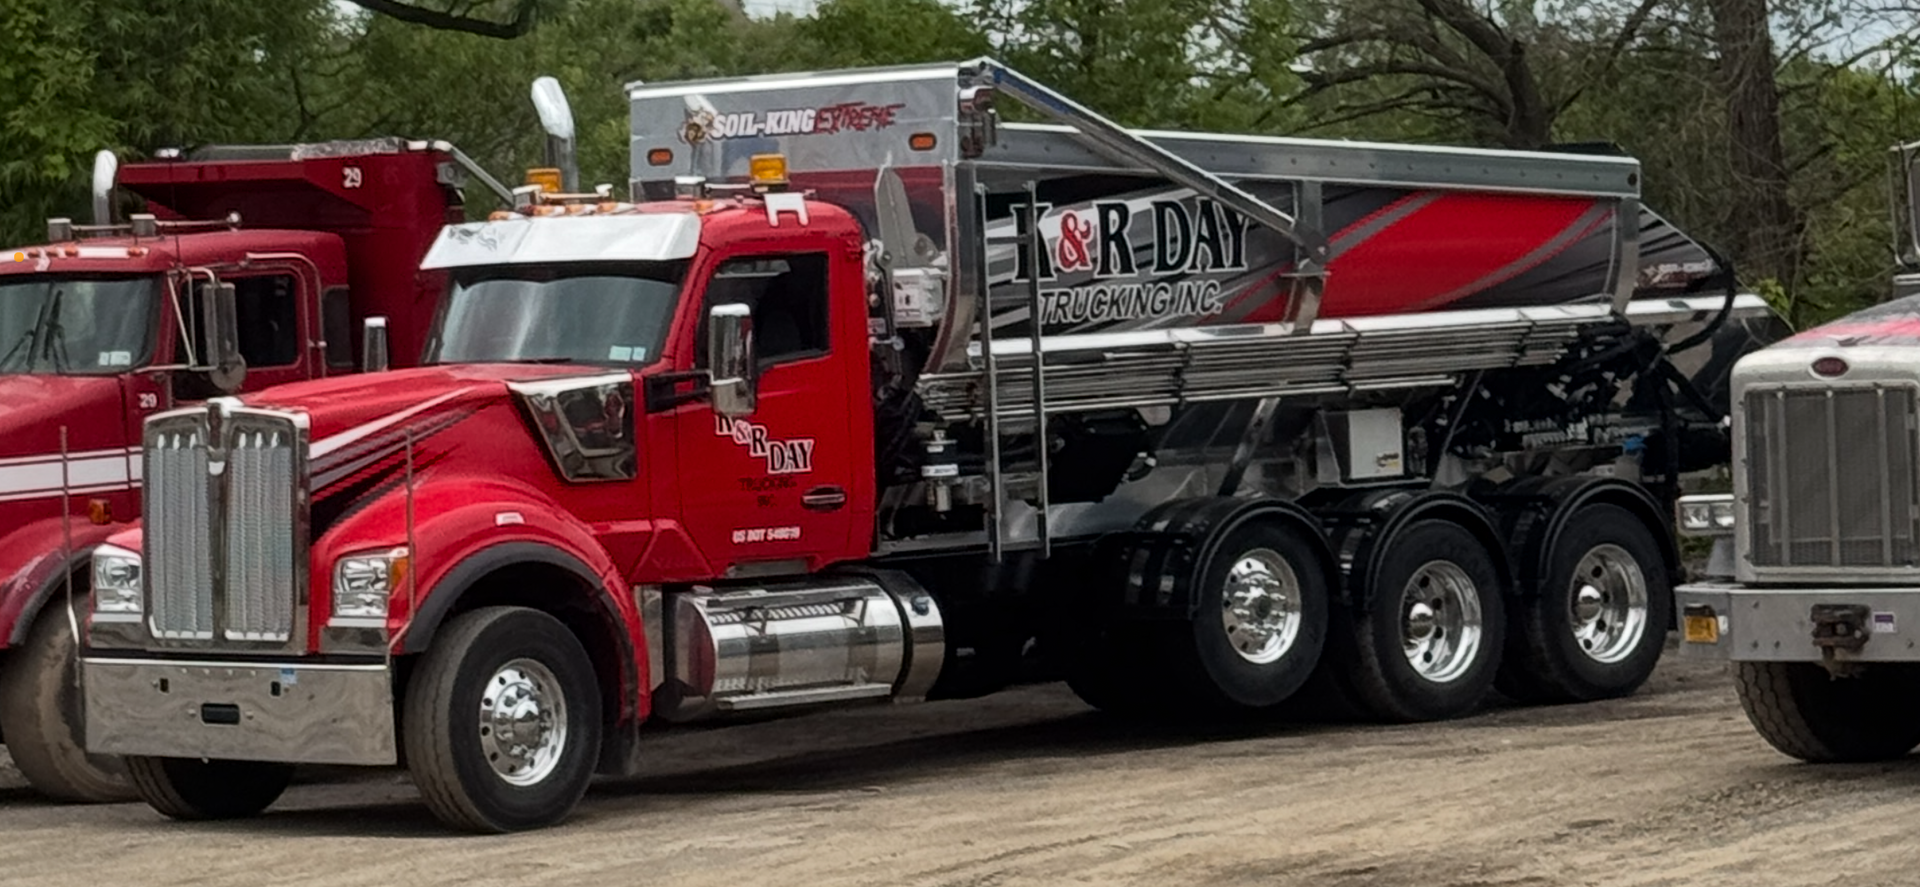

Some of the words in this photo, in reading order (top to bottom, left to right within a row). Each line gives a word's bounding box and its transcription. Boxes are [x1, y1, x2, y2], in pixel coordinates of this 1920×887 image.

[712, 108, 816, 139] SOIL-KING
[342, 166, 362, 188] 29
[1150, 196, 1249, 275] DAY
[1039, 282, 1169, 324] TRUCKING
[1174, 279, 1223, 315] INC.
[137, 393, 157, 408] 29
[766, 438, 815, 475] DAY
